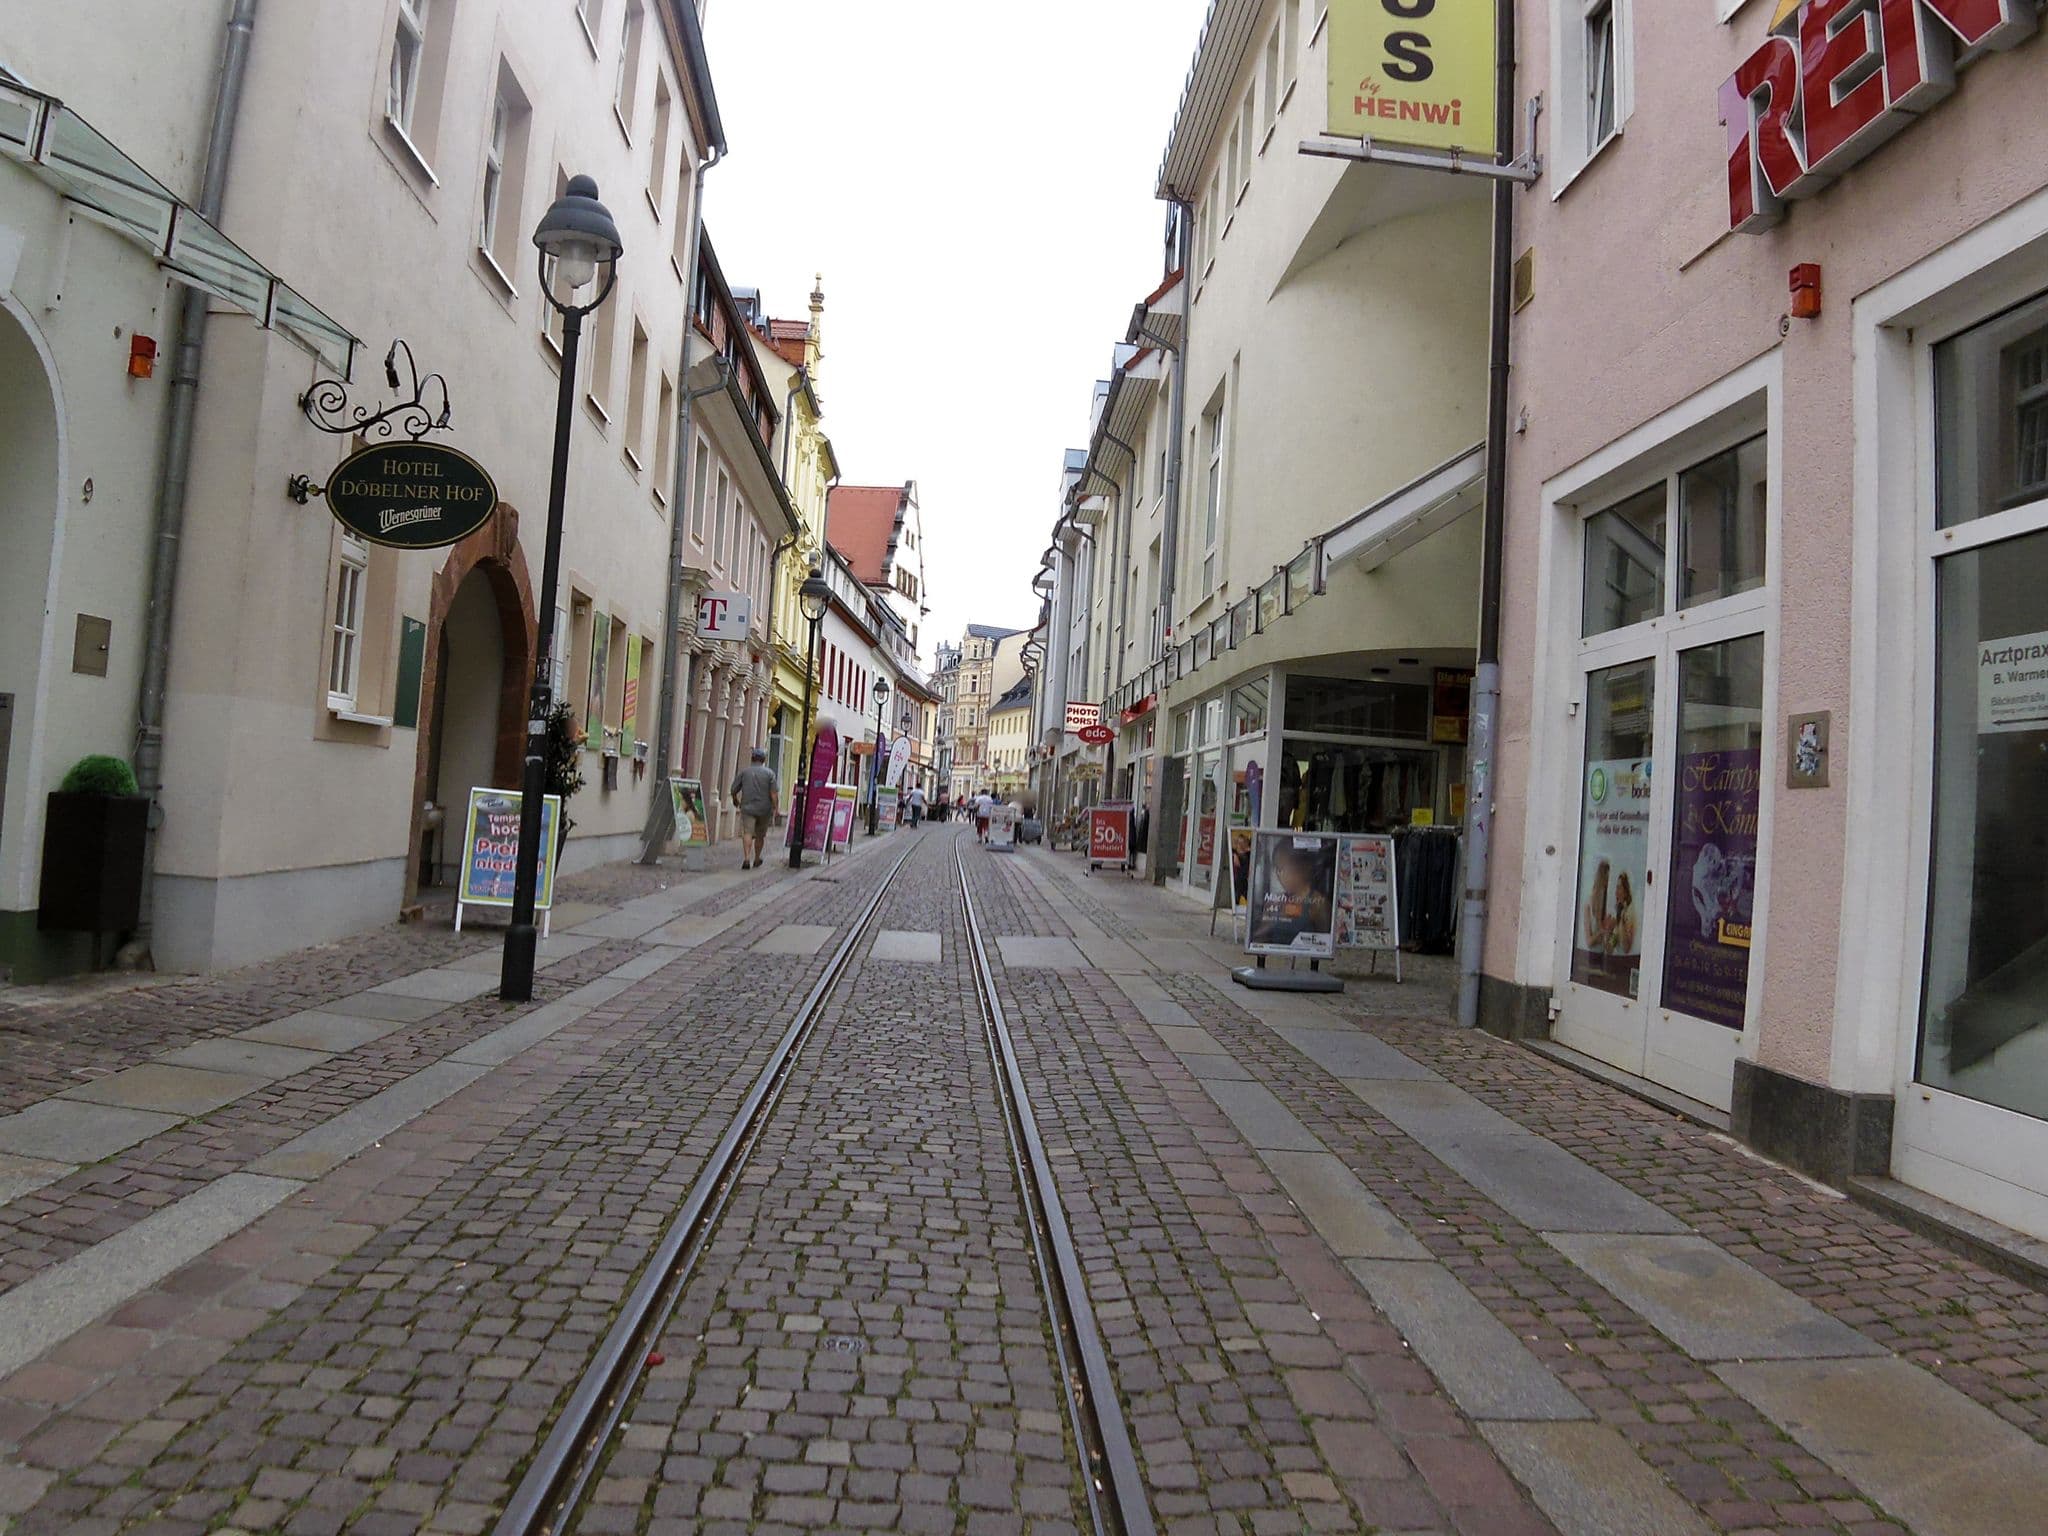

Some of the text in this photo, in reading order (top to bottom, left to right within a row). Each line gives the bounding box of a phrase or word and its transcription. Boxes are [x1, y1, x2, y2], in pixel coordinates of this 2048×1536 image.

[1360, 76, 1381, 95] by
[383, 459, 445, 477] HOTEL
[340, 480, 484, 501] DÖBELNER HOF
[378, 505, 443, 530] Wernesgrüner
[701, 598, 728, 632] T
[1066, 707, 1099, 717] PHOTO
[1066, 716, 1098, 726] PORST
[1085, 728, 1107, 738] edc
[491, 822, 520, 836] hoc
[1094, 826, 1124, 844] 50%
